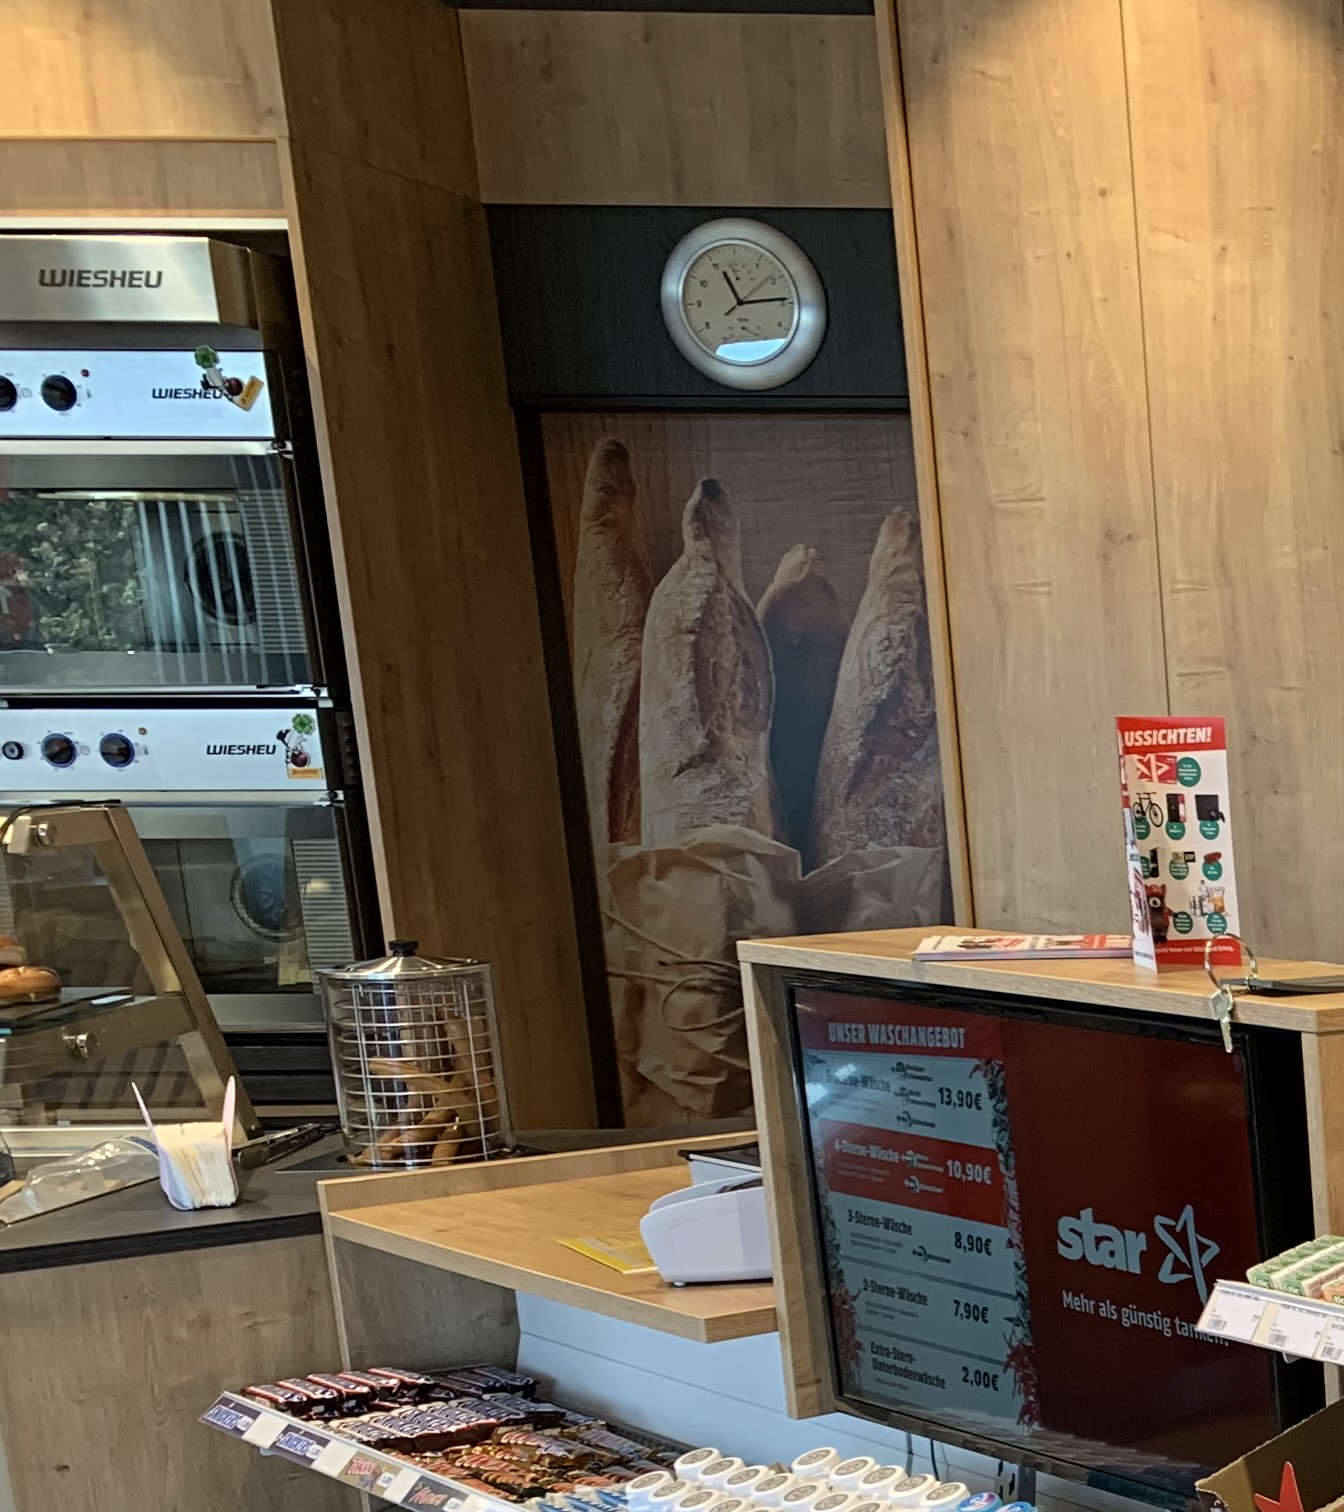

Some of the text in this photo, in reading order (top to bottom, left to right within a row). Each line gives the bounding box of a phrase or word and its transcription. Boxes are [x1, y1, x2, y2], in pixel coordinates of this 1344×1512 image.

[38, 268, 163, 290] WIESHEU
[205, 742, 277, 758] WIESHEU
[828, 1022, 965, 1050] UNSER WASCHANGEBOT
[937, 1085, 983, 1112] 13,90€
[834, 1137, 992, 1185] 4-Sterne-Wäsche 10,90€
[847, 1208, 993, 1256] 3-Sterne-Wäsche 8,90€
[1056, 1208, 1148, 1275] star
[862, 1278, 989, 1325] 2-Sterne-Wäsche 7,90€
[1062, 1290, 1172, 1338] Mehr als günstig
[869, 1340, 917, 1365] Extra-Stern-
[872, 1360, 1000, 1391] Unterbodenwäsche 2,00€
